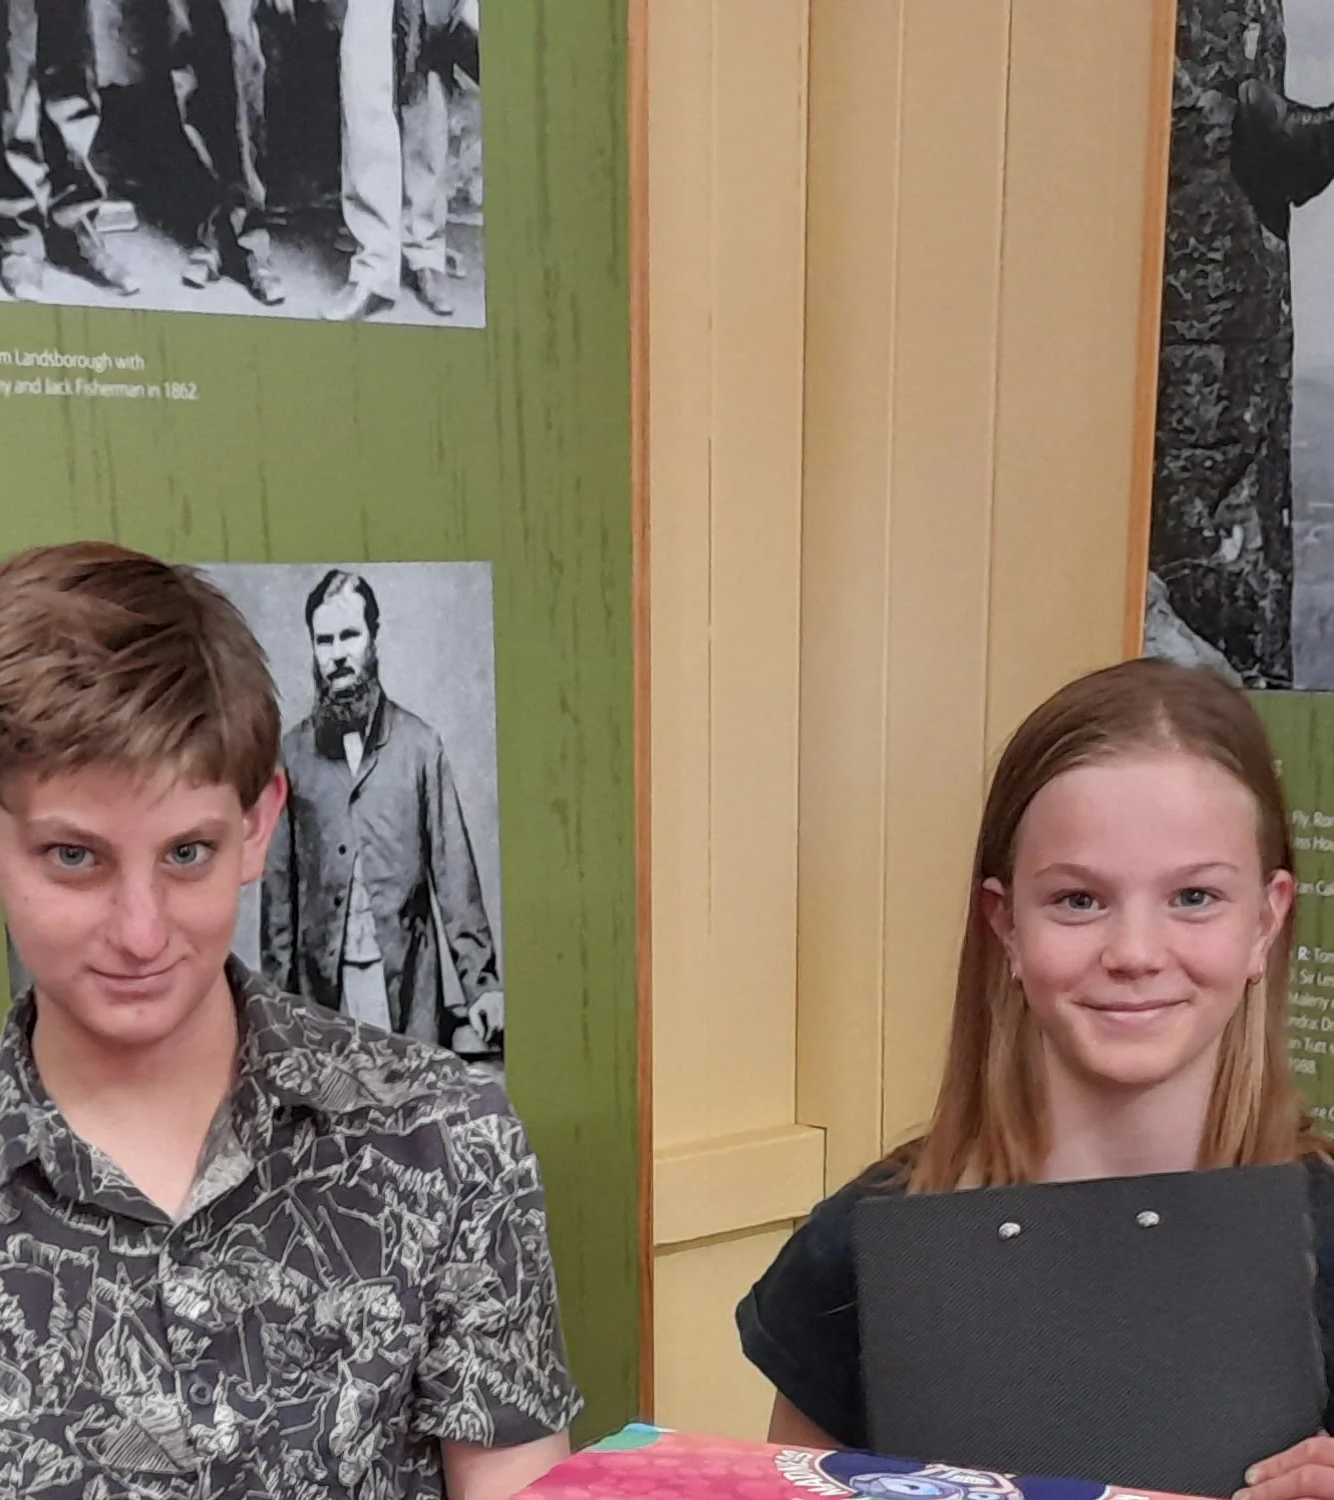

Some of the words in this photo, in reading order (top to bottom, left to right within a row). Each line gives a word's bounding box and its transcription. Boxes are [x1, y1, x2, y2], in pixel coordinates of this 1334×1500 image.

[16, 349, 112, 373] Landsborough
[115, 354, 144, 370] with
[14, 378, 41, 394] and
[75, 378, 144, 397] Fisherman
[148, 384, 160, 397] in
